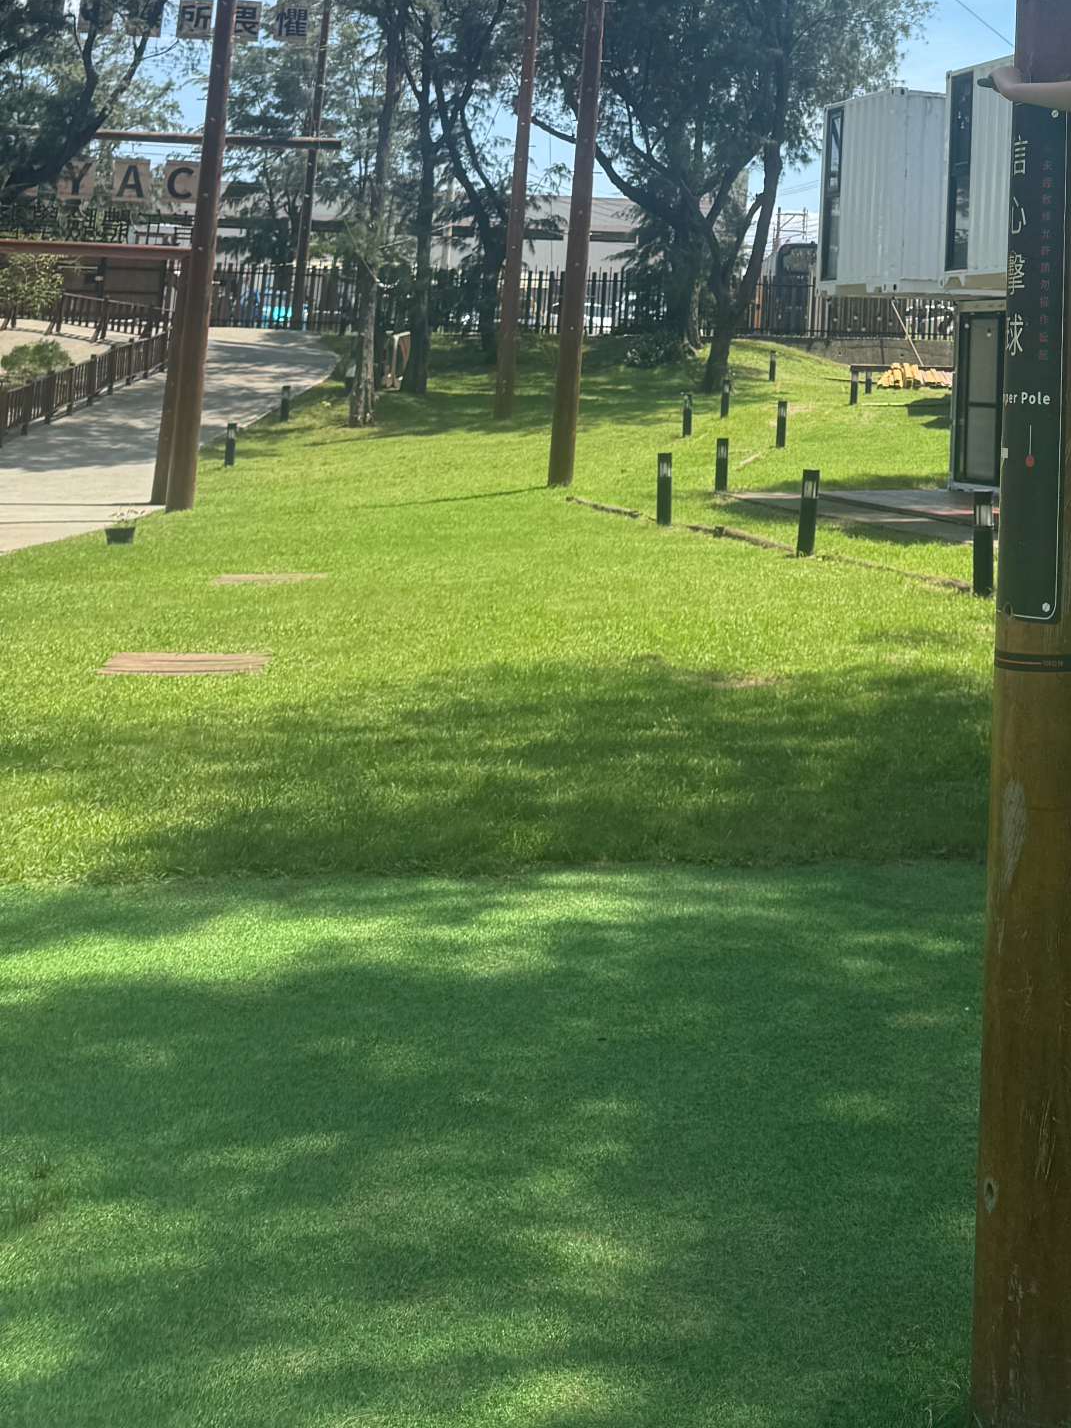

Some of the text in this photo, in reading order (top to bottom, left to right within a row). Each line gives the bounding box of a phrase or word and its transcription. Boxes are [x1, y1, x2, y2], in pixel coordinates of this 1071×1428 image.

[1005, 134, 1028, 357] 信心擊球
[1021, 391, 1051, 405] Pole
